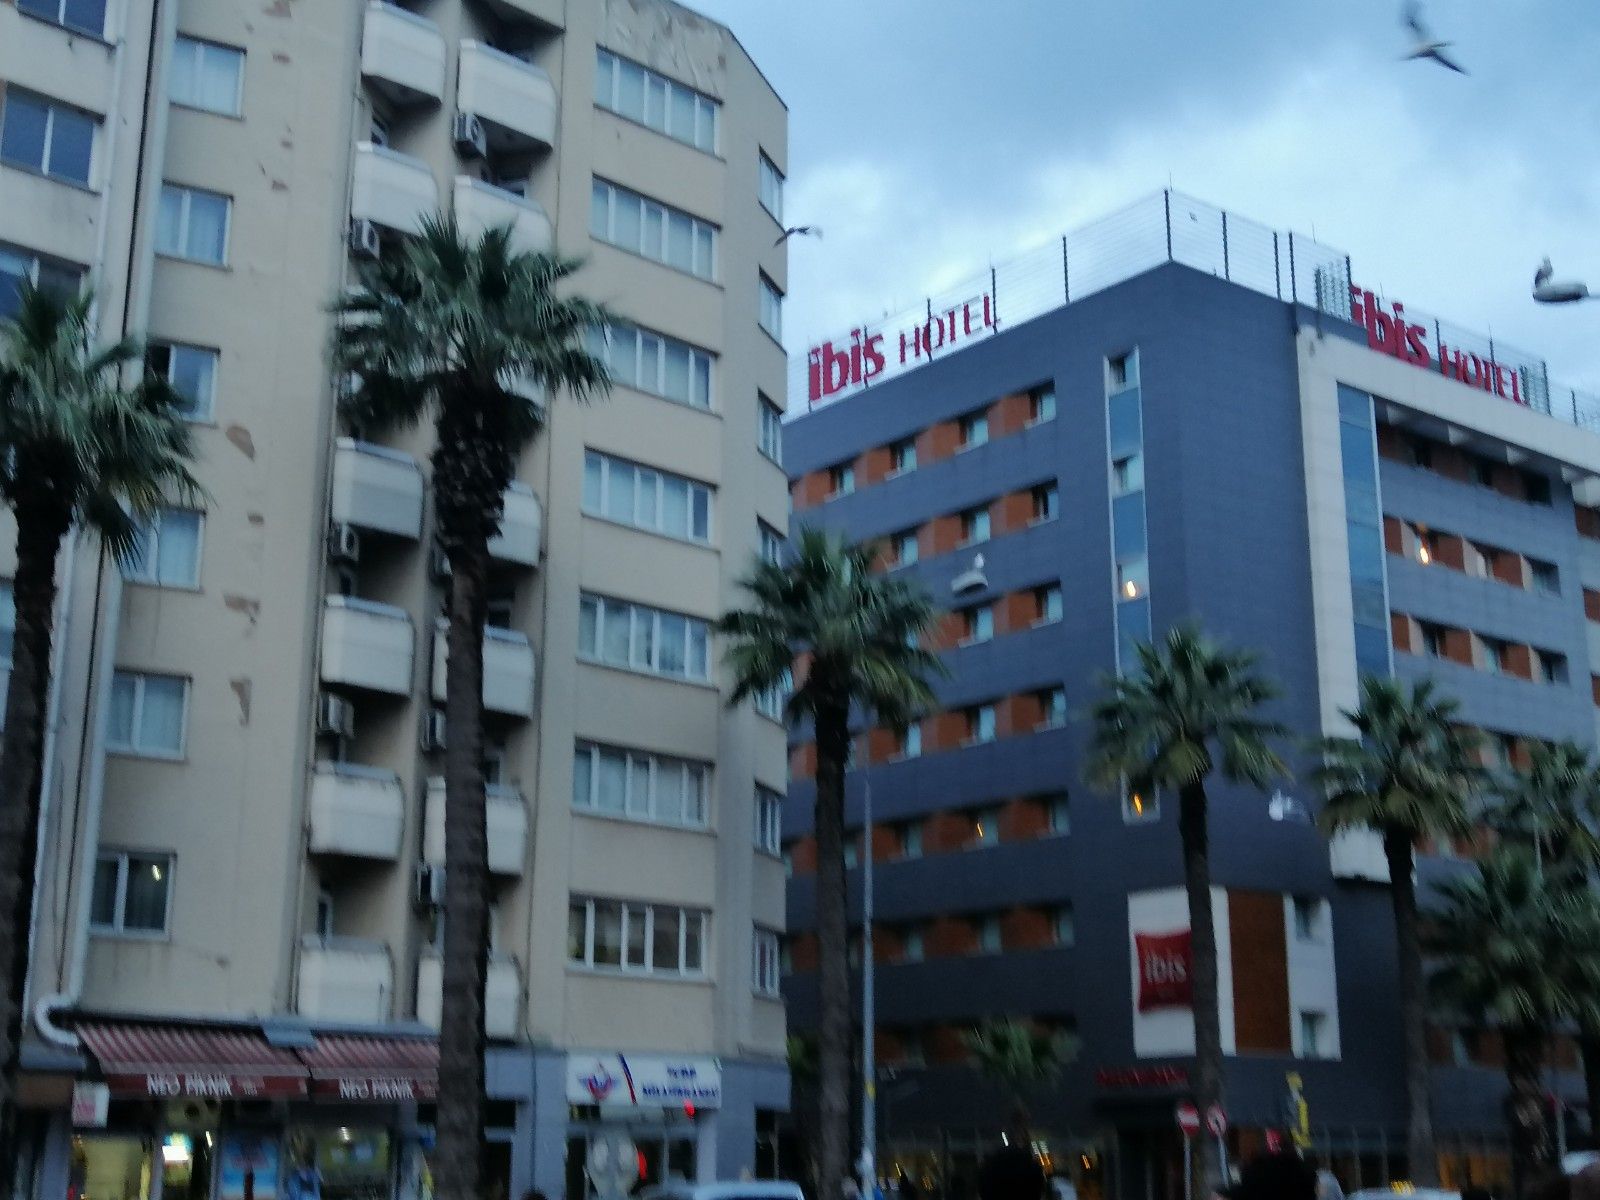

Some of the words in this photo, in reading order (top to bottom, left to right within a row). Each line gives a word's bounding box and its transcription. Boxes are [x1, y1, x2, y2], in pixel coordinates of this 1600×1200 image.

[809, 328, 885, 402] ibis
[900, 293, 1001, 364] HOTEL
[1350, 284, 1431, 370] ibis
[1439, 343, 1532, 407] HOTEL
